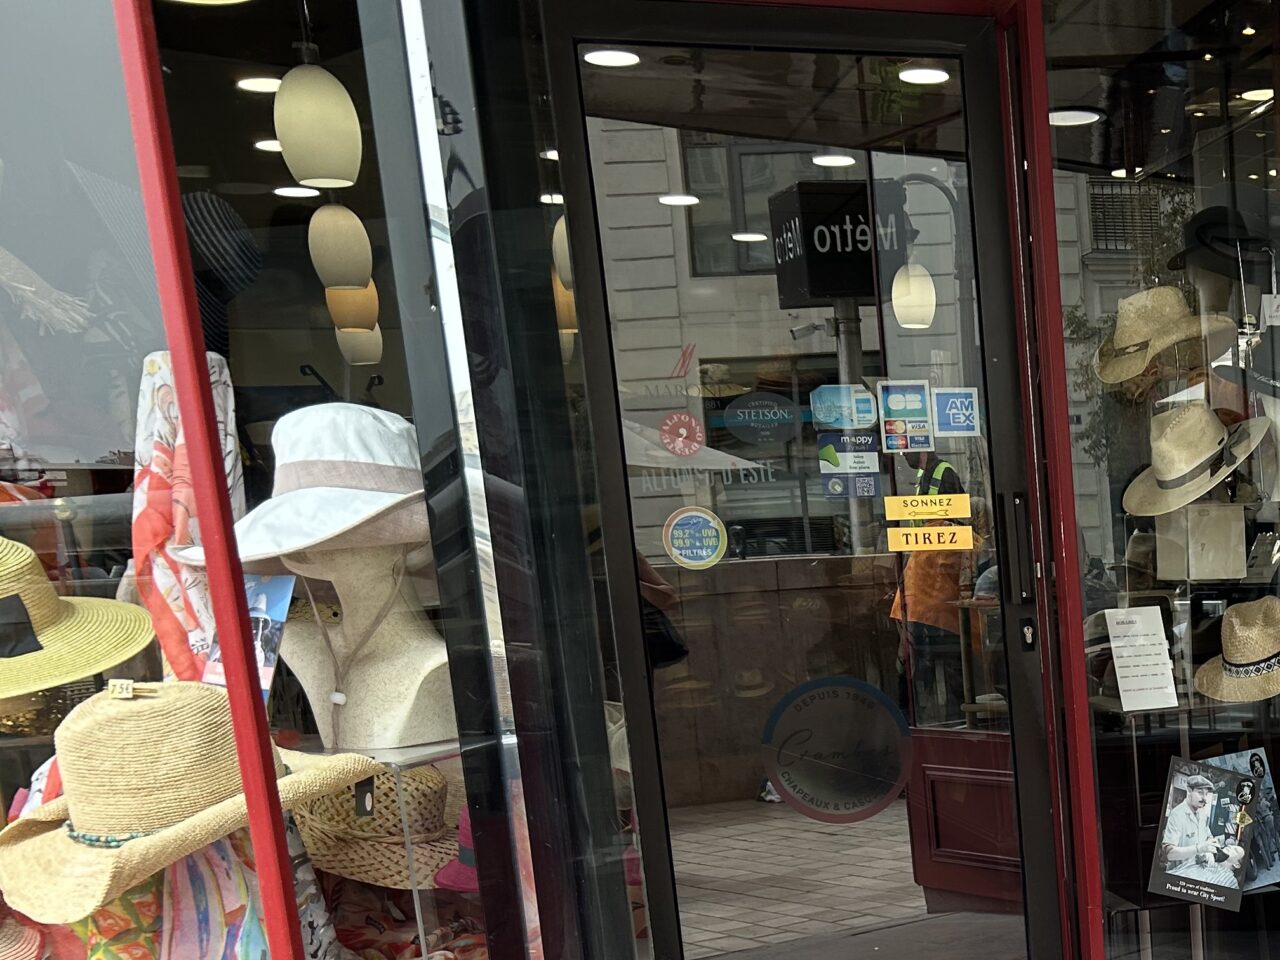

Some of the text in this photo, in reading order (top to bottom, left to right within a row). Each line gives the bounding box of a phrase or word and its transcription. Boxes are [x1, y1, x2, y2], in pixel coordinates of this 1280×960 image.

[737, 409, 789, 420] STETSON
[903, 498, 952, 507] SONNEZ
[702, 528, 717, 537] UVA
[902, 532, 958, 545] TIREZ
[111, 684, 130, 694] 75€
[793, 690, 840, 713] DEPUIS
[780, 771, 830, 810] CHAPEAUX
[1166, 883, 1181, 892] Proud
[1200, 891, 1209, 900] City
